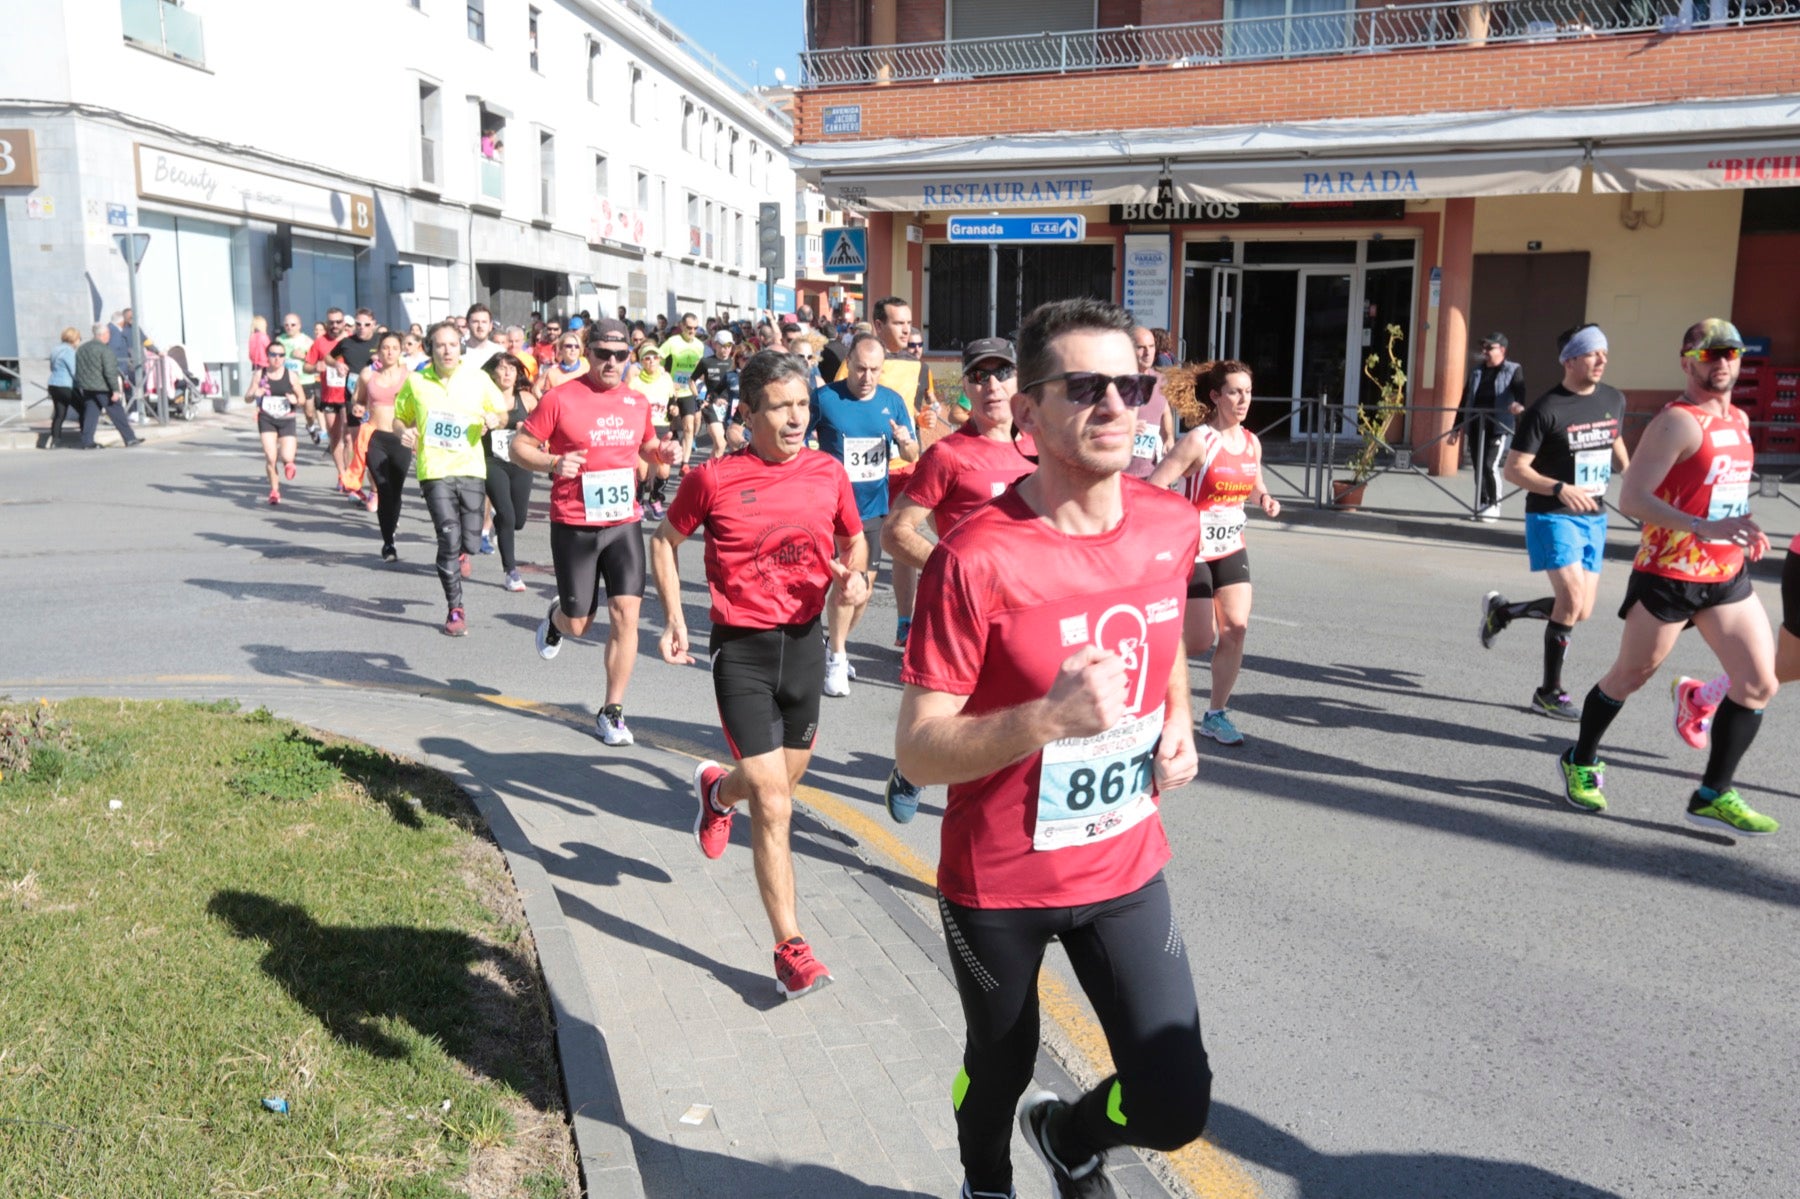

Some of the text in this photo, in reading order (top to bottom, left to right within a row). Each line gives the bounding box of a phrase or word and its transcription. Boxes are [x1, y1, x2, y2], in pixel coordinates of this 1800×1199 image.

[154, 155, 217, 201] Beauty
[1302, 169, 1418, 194] PARADA
[923, 179, 1093, 205] RESTAURANTE
[357, 201, 368, 229] B
[1121, 201, 1240, 220] BICHITOS
[951, 223, 1058, 235] Granada A-44
[434, 422, 461, 439] 859
[596, 414, 624, 429] edp
[594, 485, 630, 505] 135
[1066, 750, 1150, 812] 867
